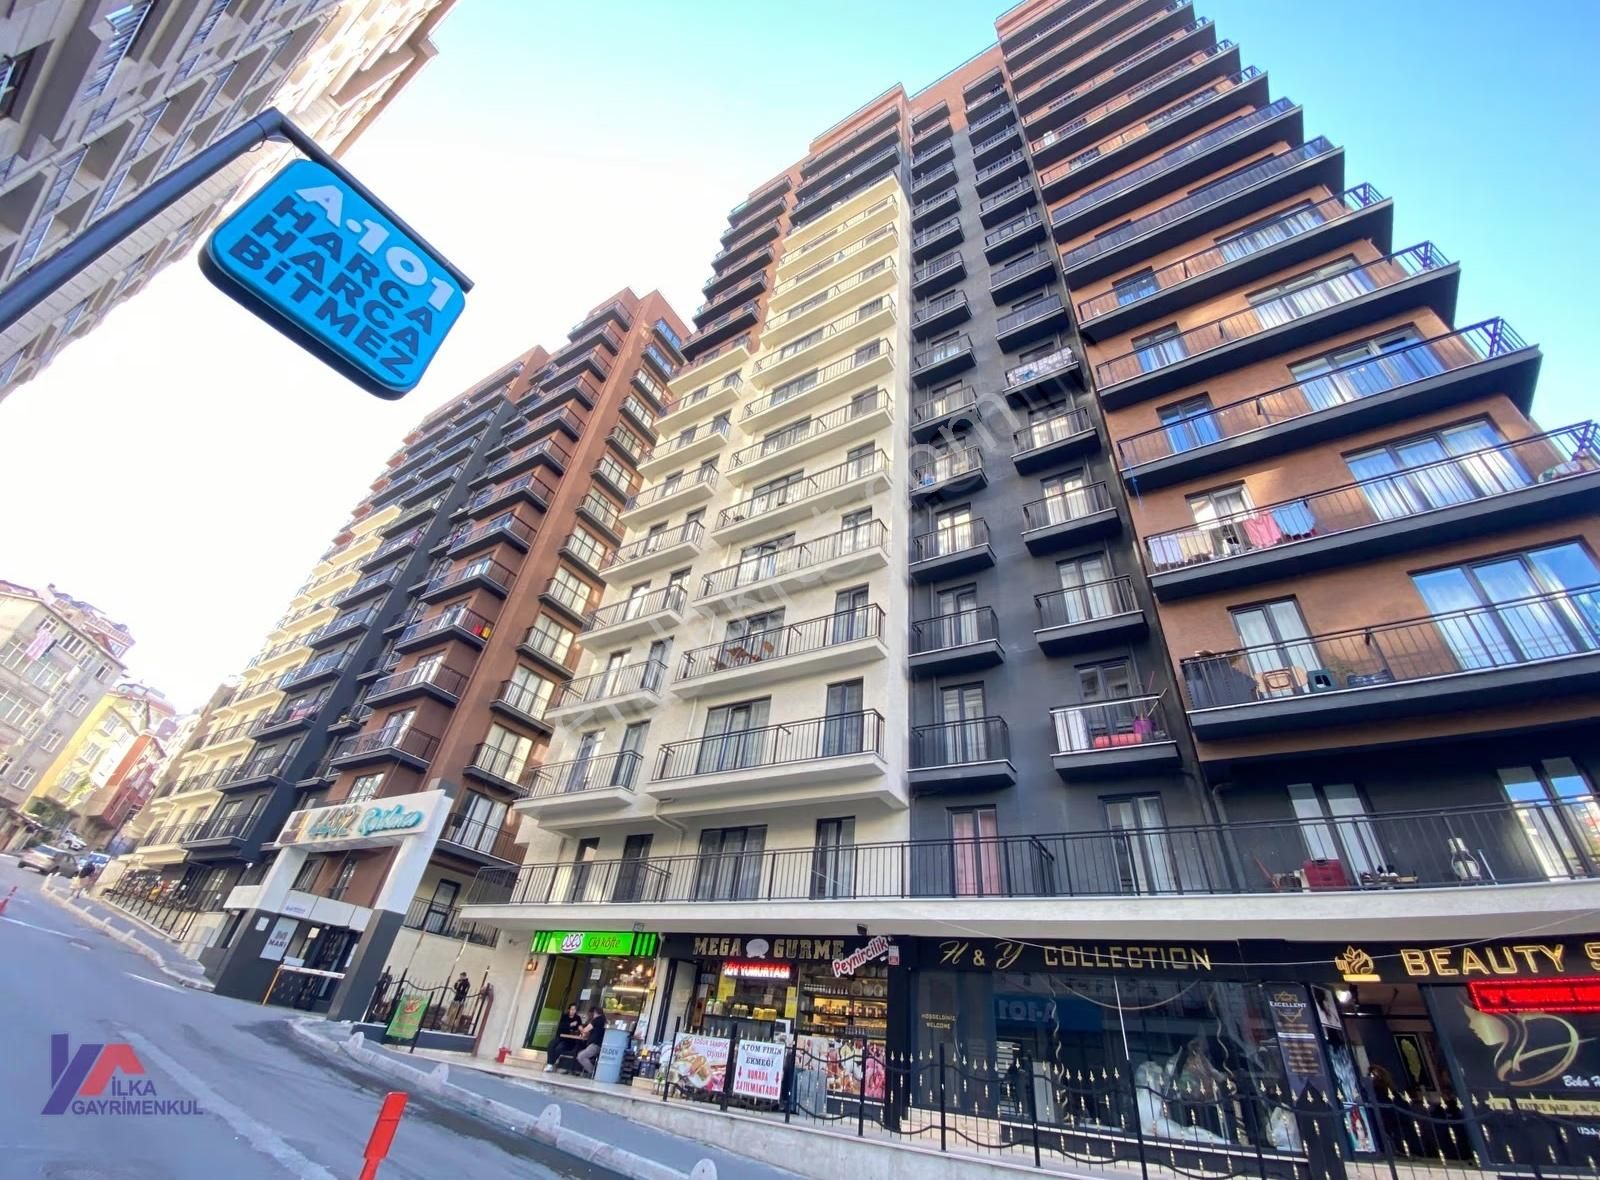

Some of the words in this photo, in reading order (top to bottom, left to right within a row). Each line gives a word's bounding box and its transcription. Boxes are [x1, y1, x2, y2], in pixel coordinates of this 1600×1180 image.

[272, 195, 433, 336] HARCA
[296, 184, 455, 312] A.101
[250, 213, 420, 358] HARCA
[692, 937, 742, 957] MEGA
[773, 939, 846, 960] GURME
[833, 936, 889, 976] Peynircilik
[973, 949, 985, 967] &
[1044, 945, 1212, 971] COLLECTION
[1401, 944, 1565, 976] BEAUTY
[741, 1043, 760, 1052] ATOM
